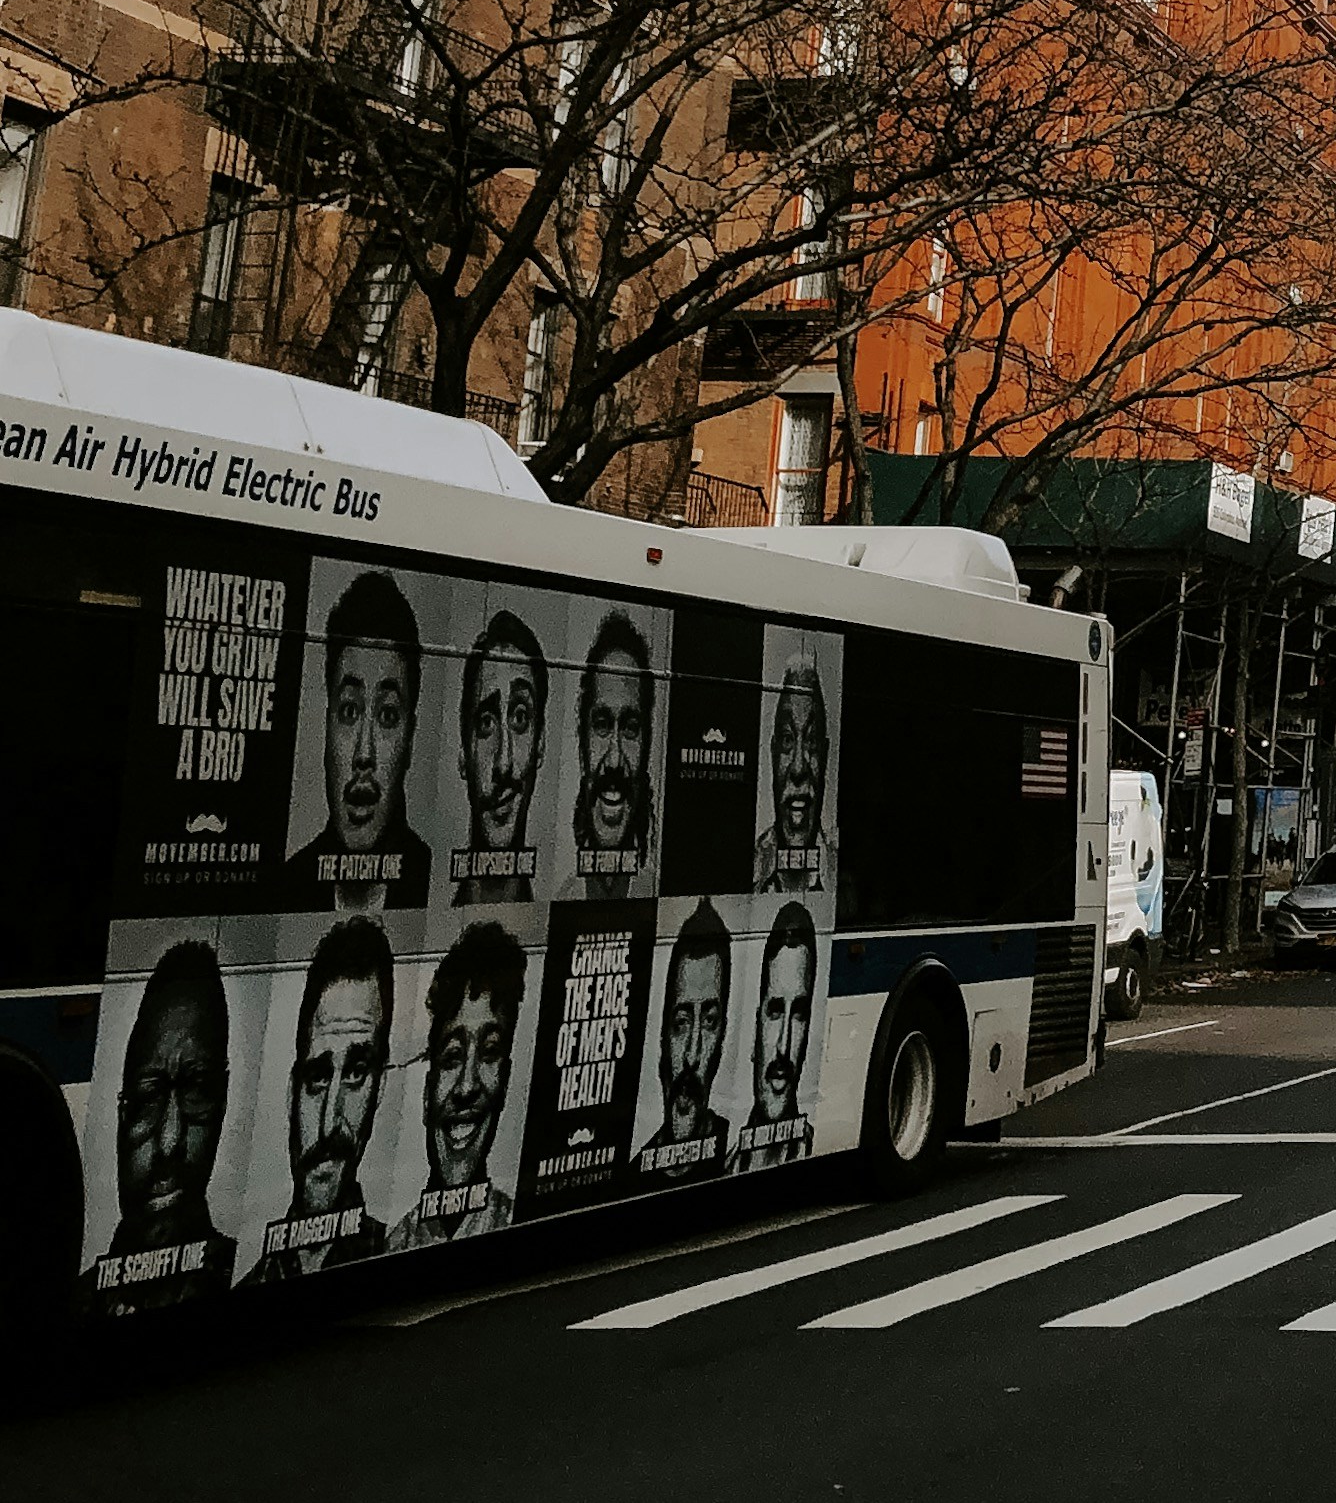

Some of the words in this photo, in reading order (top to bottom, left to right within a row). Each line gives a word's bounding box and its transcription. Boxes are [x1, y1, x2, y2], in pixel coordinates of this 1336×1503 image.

[53, 425, 106, 471] Air
[112, 435, 217, 491] Hybrid
[222, 454, 326, 512] Electric
[333, 478, 381, 521] Bus
[165, 566, 287, 630] WHATEVER
[164, 618, 211, 674] YOU
[211, 624, 284, 680] GROW
[158, 673, 211, 727] WILL
[217, 677, 276, 731] SAVE
[175, 728, 194, 780] A
[199, 729, 246, 783] BRO
[145, 843, 260, 863] MOVEMBER.COM
[317, 854, 338, 881] THE
[339, 854, 381, 881] PATCHY
[381, 853, 403, 880] ONE
[453, 852, 471, 878] THE
[516, 851, 535, 876] ONE
[563, 975, 594, 1022] THE
[593, 972, 633, 1018] FACE
[556, 1021, 579, 1068] OF
[578, 1015, 628, 1064] MEN'S
[557, 1059, 616, 1112] HEALTH
[640, 1148, 656, 1173] THE
[701, 1136, 717, 1160] ONE
[421, 1190, 441, 1218] THE
[468, 1182, 489, 1210] ONE
[266, 1223, 289, 1254] THE
[288, 1211, 341, 1249] RAGGEDY
[341, 1207, 363, 1238] ONE
[97, 1257, 122, 1290] THE
[123, 1245, 182, 1284] SCRUFFY
[181, 1240, 207, 1272] ONE
